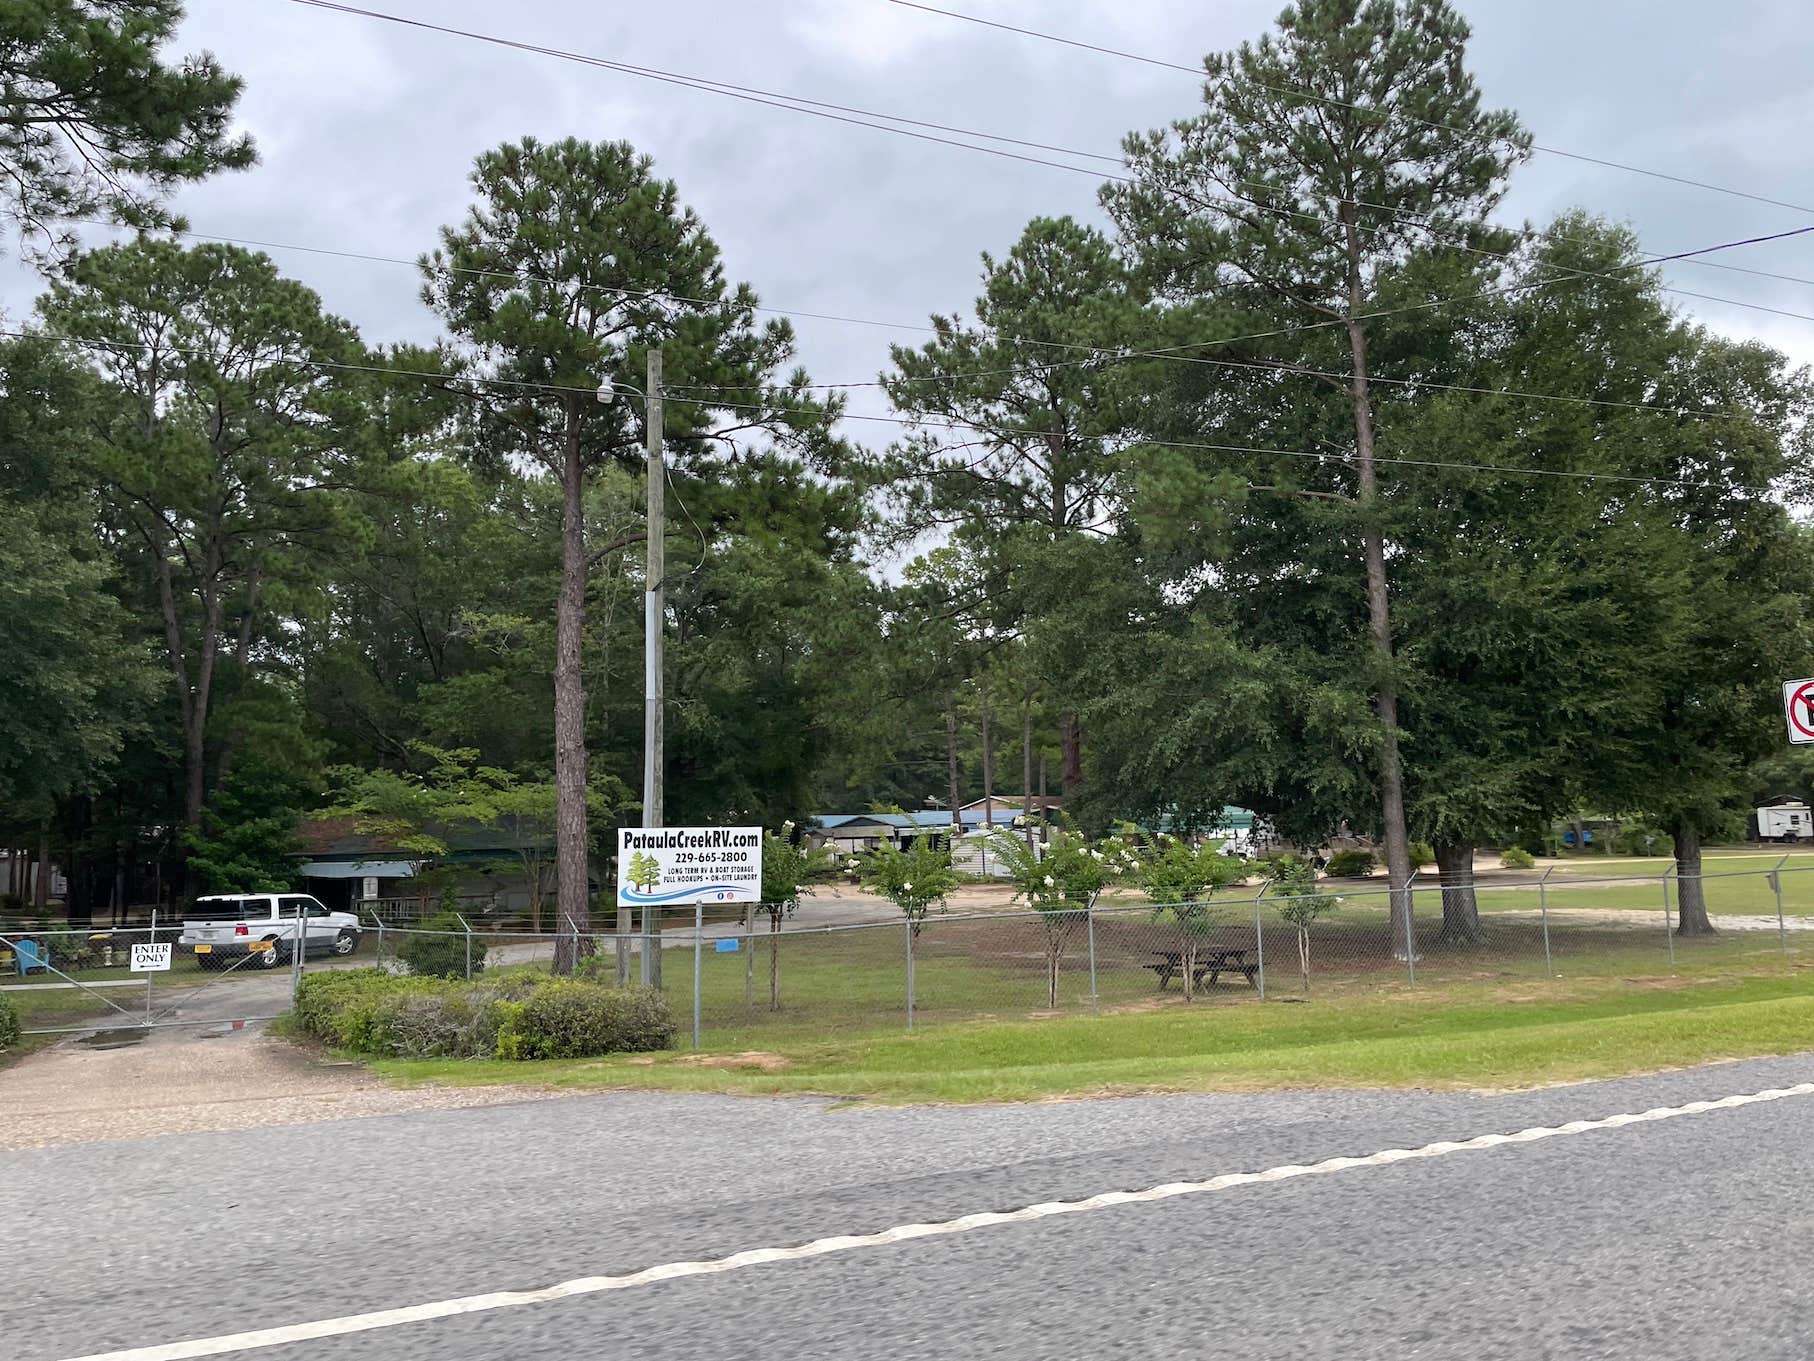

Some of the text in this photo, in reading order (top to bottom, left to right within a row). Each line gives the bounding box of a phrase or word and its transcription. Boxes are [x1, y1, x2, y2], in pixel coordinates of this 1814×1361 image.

[624, 830, 758, 849] PataulaCreekRV.com
[675, 852, 748, 863] 229-665-2800
[668, 867, 683, 875] LONG
[731, 865, 754, 873] STORAGE
[710, 874, 732, 882] ON-SITE
[734, 873, 758, 881] LAUNDRY
[135, 945, 168, 954] ENTER
[136, 954, 166, 963] ONLY
